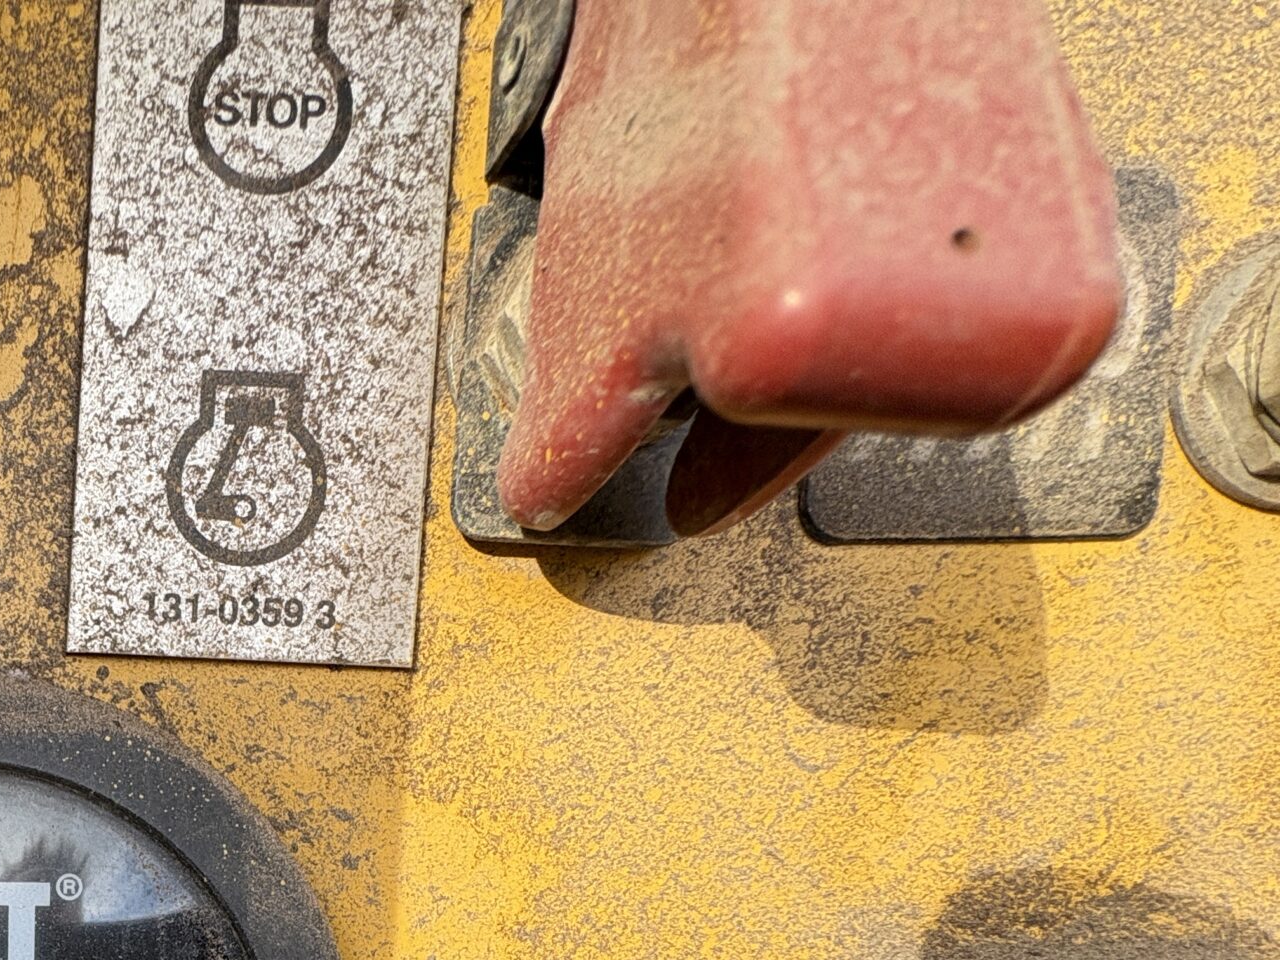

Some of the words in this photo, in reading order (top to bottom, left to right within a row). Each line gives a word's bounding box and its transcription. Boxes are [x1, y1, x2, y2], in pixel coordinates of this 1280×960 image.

[214, 91, 327, 130] STOP
[142, 592, 304, 628] 131-0359
[315, 600, 337, 630] 3
